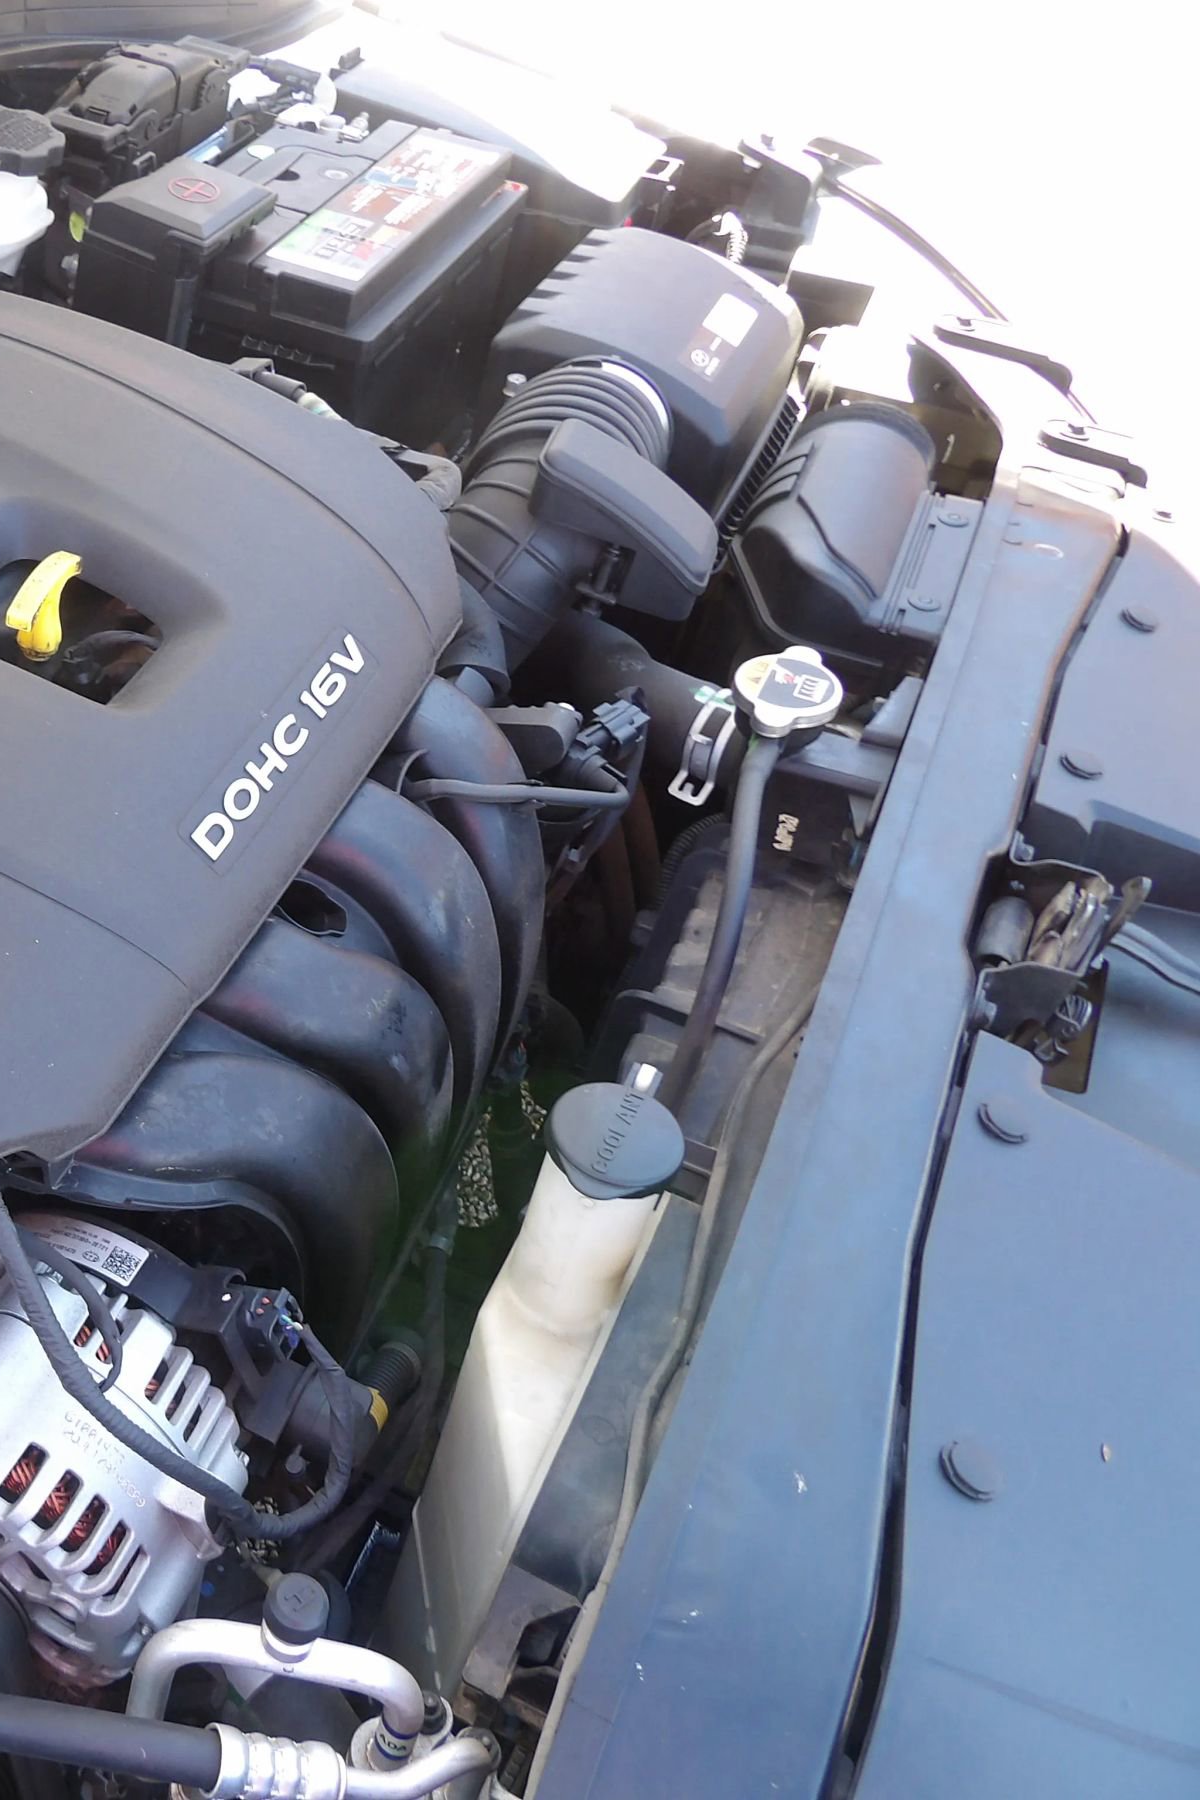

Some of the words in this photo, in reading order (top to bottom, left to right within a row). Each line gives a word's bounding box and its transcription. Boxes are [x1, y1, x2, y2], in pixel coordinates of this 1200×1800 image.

[190, 712, 310, 862] DOHC
[299, 632, 367, 720] 16V
[591, 1093, 644, 1174] COOLANT
